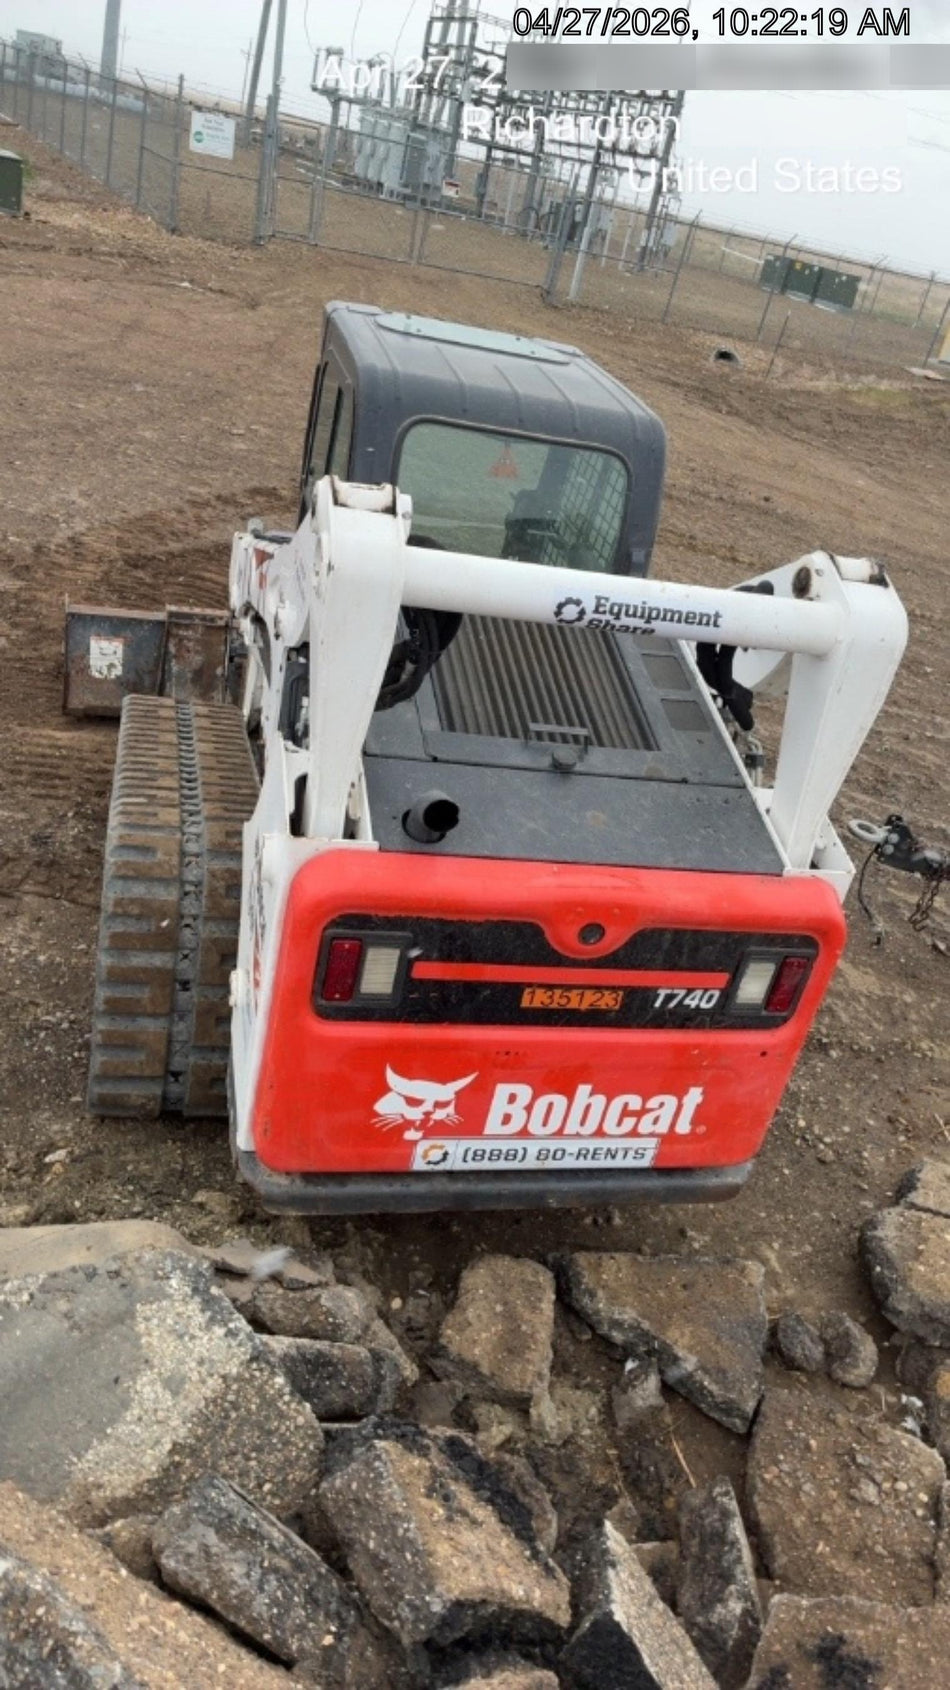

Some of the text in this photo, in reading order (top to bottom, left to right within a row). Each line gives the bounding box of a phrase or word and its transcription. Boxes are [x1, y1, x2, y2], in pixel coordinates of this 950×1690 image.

[592, 594, 723, 628] Equipment
[525, 988, 721, 1009] 135123 T740
[482, 1082, 704, 1136] Bobcat
[461, 1146, 648, 1163] (888) 80-RENTS
